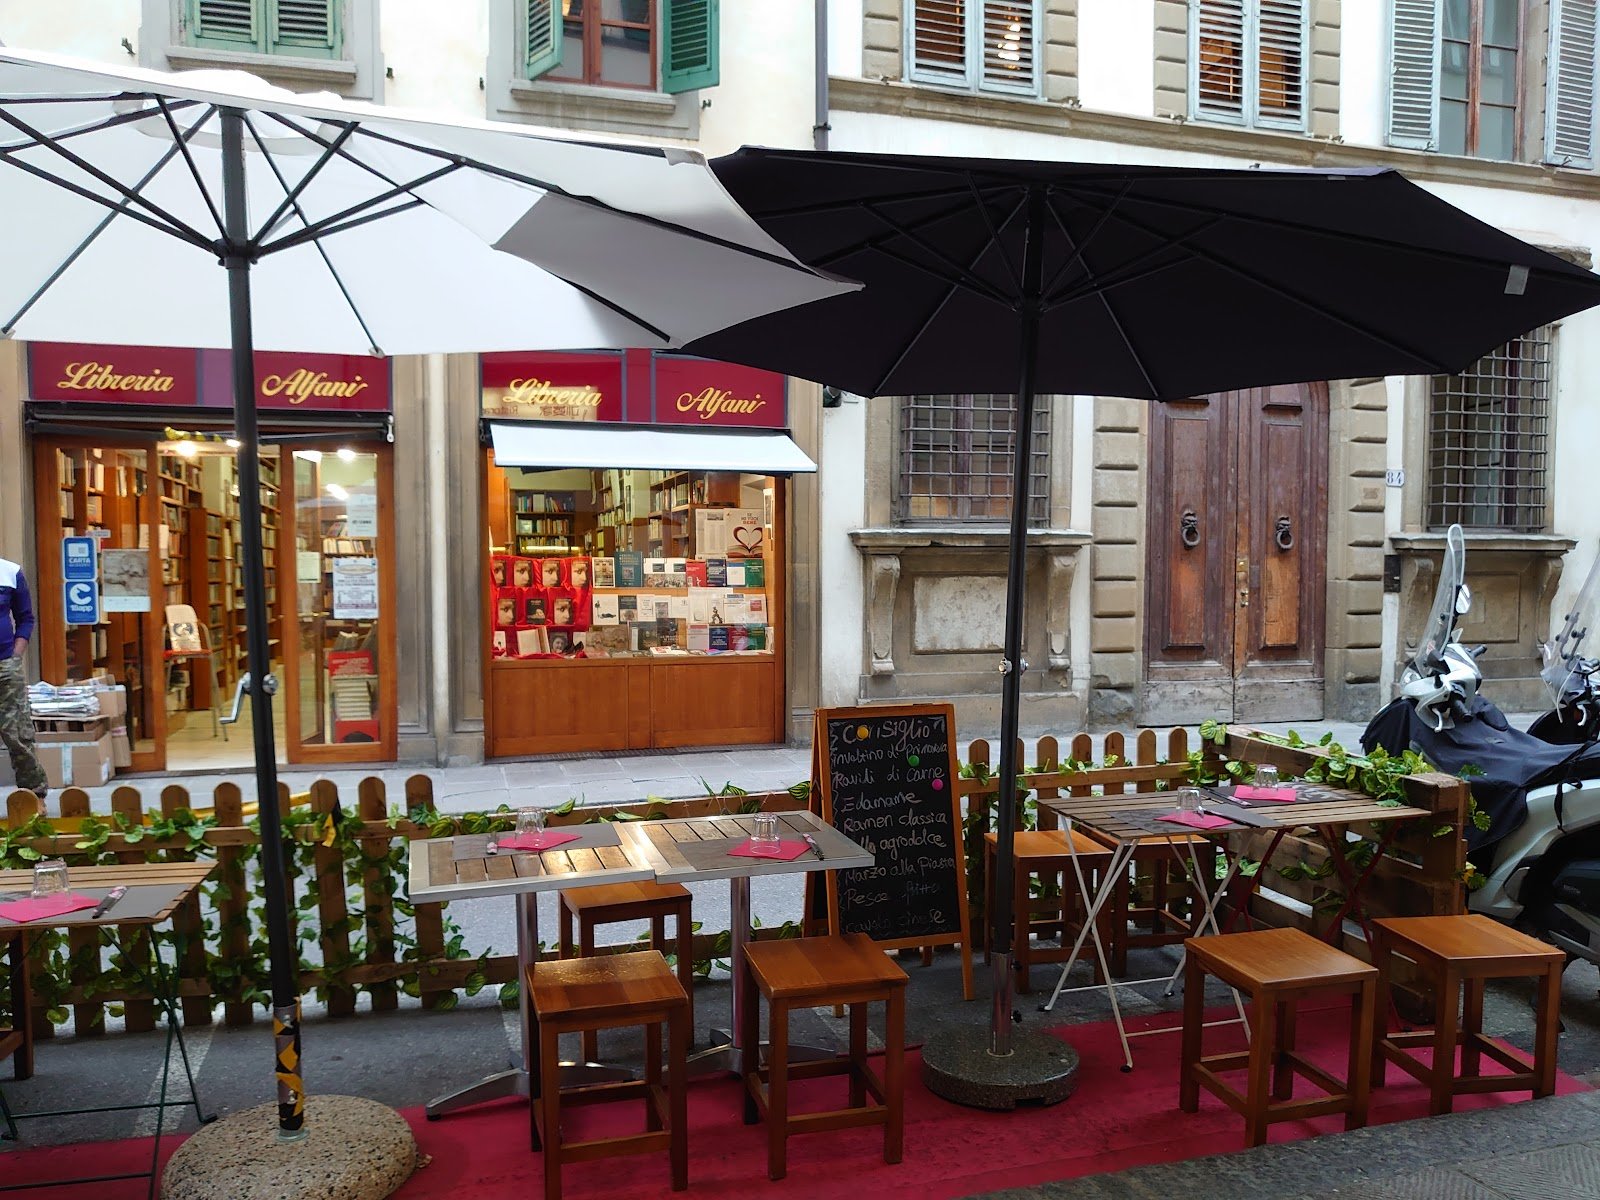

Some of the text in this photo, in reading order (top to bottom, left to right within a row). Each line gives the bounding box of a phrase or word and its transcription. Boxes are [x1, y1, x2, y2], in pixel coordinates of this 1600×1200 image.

[57, 361, 369, 404] Libreria Alfani
[502, 377, 766, 420] Libreria Alfani
[1387, 471, 1402, 485] 84
[887, 764, 900, 781] di
[841, 791, 922, 813] Edamame
[843, 814, 894, 835] Ramen
[889, 858, 916, 877] alla
[843, 888, 888, 911] Pesce
